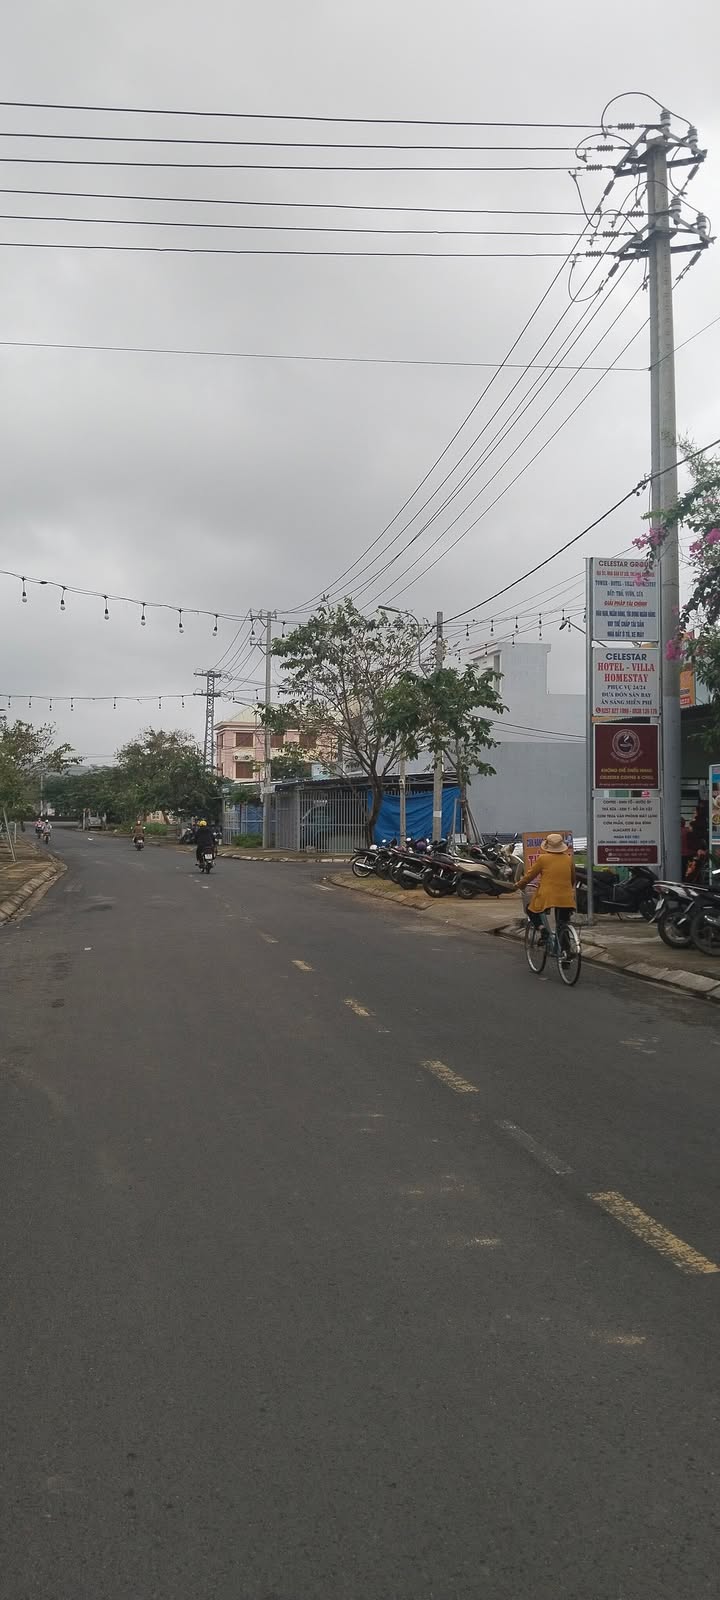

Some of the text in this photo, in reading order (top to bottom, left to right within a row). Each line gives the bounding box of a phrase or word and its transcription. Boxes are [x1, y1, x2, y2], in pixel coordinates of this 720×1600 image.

[599, 560, 628, 568] CELESTAR
[598, 663, 624, 671] HOTEL
[632, 663, 655, 671] VILLA
[604, 674, 648, 682] HOMESTAY
